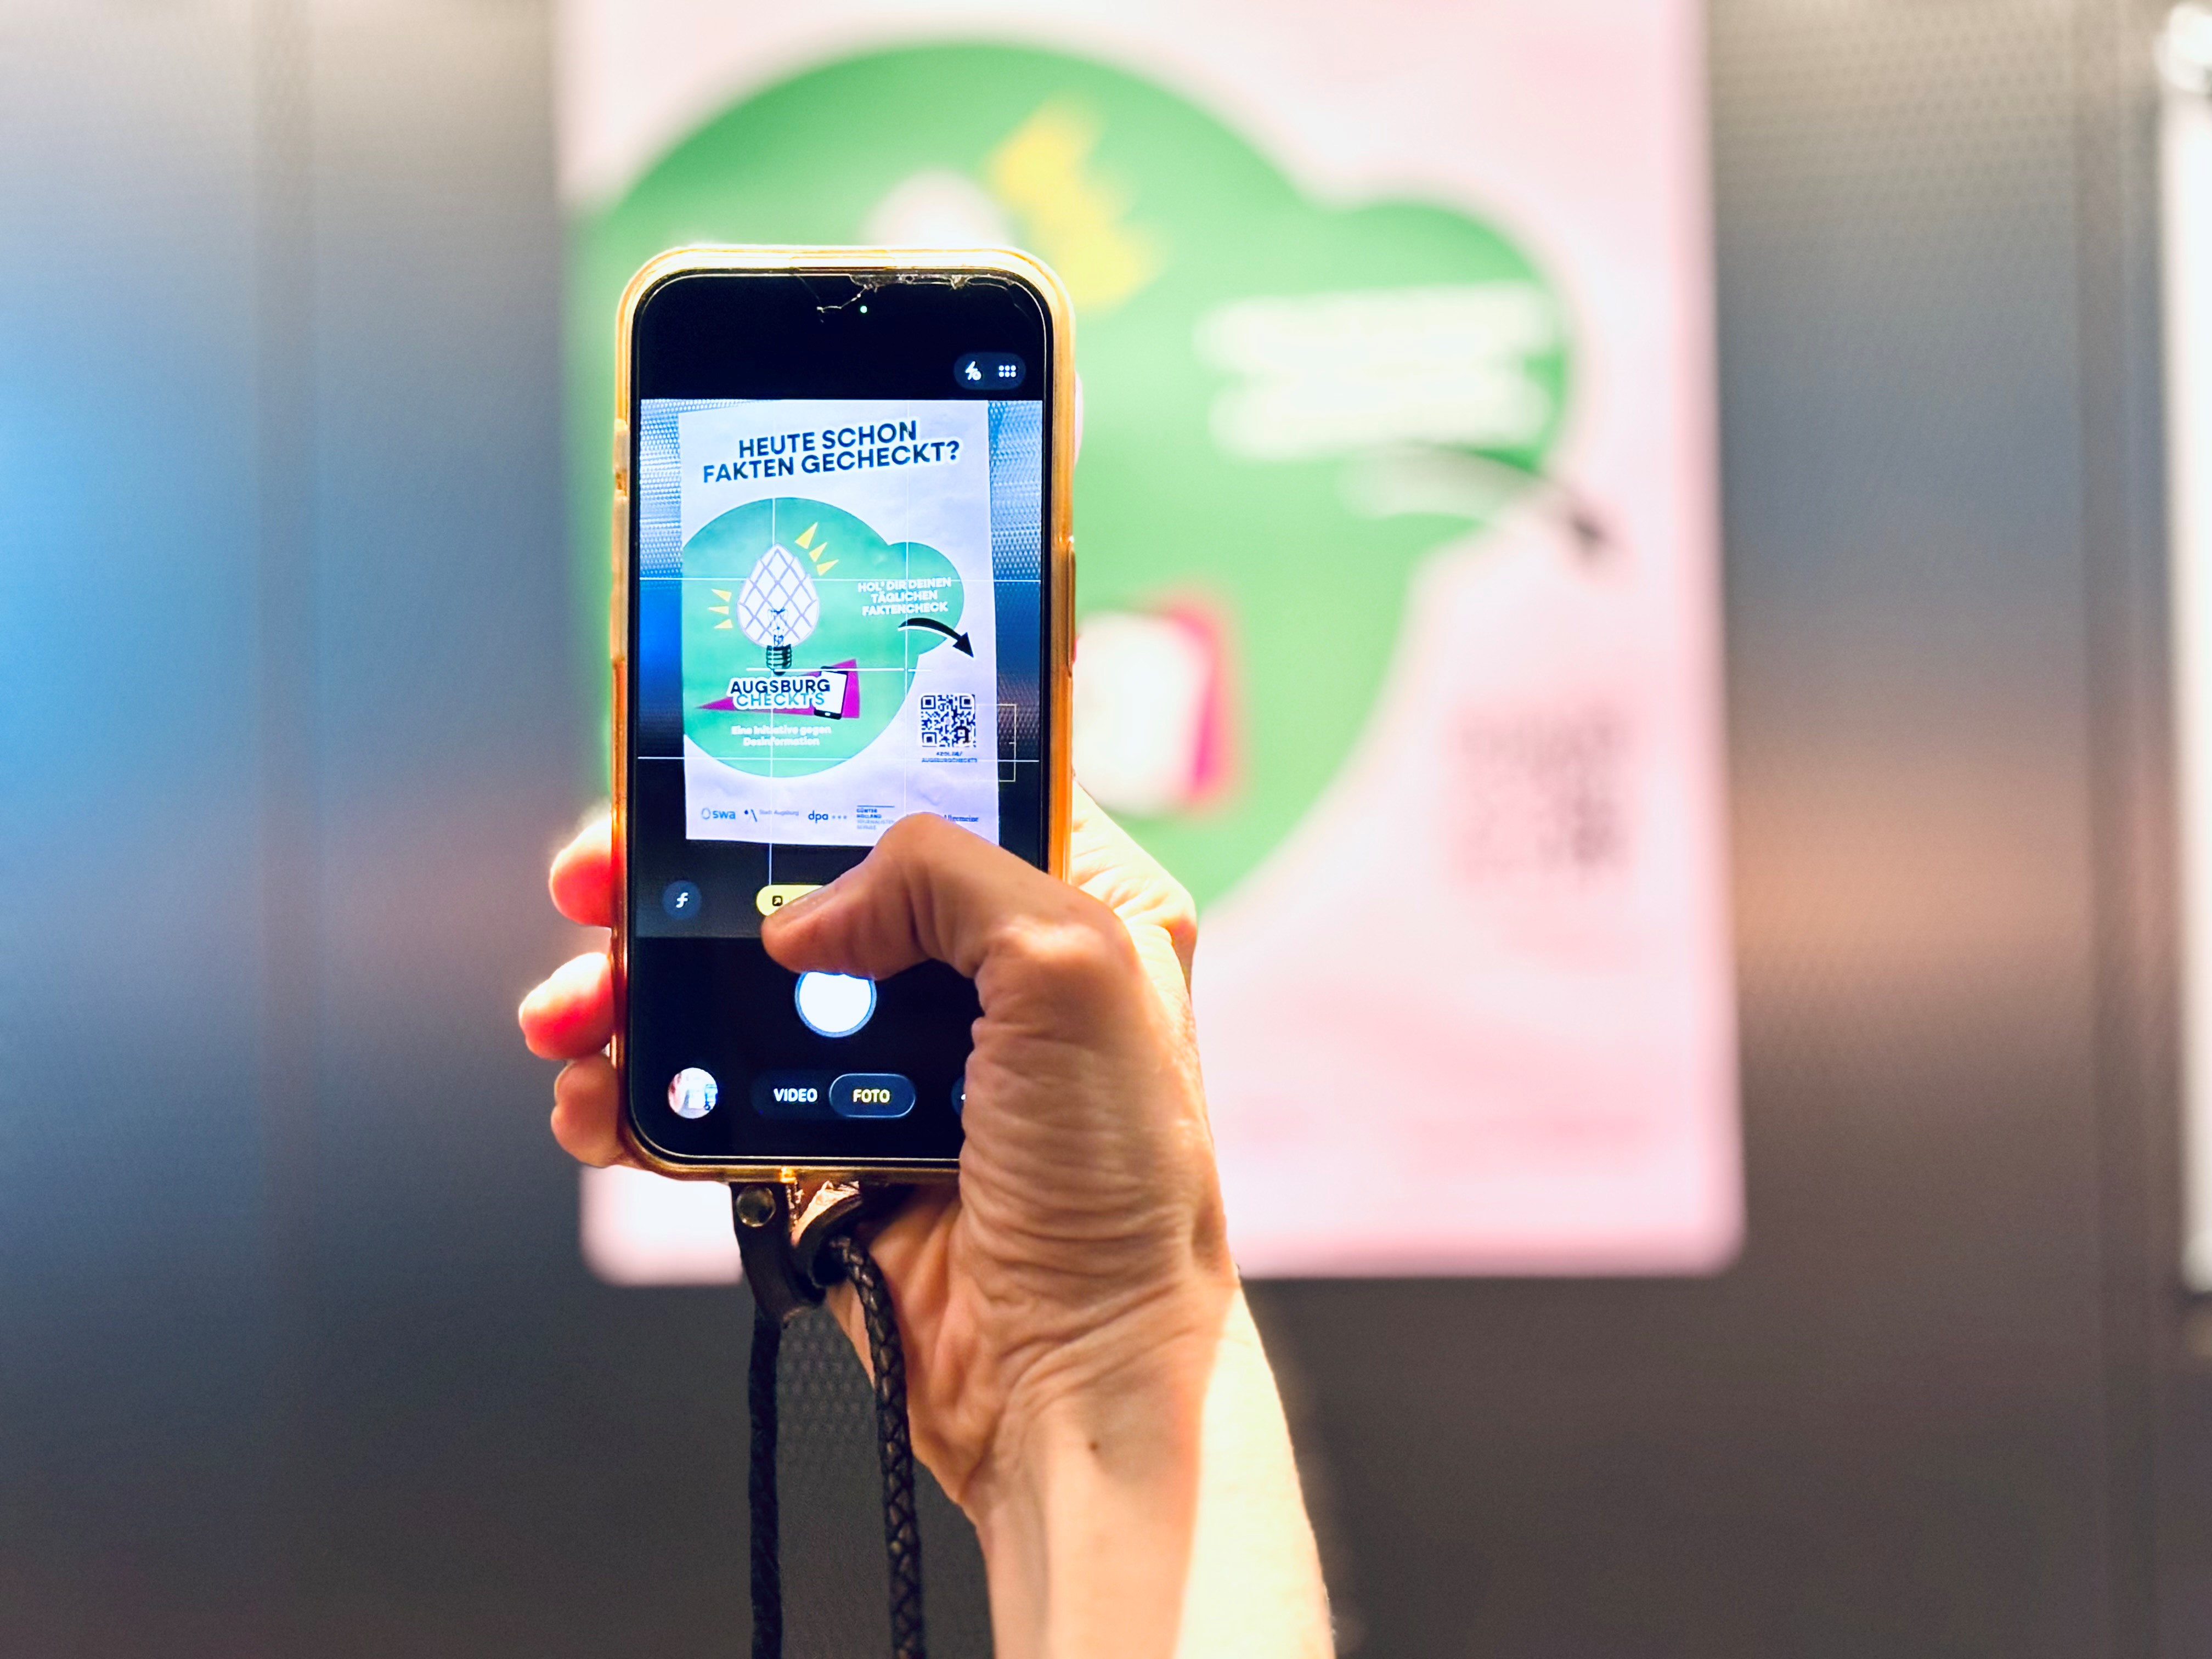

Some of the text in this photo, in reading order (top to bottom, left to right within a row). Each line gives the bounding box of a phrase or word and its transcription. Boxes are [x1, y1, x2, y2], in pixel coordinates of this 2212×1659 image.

[739, 420, 916, 458] HEUTE SCHON
[703, 440, 960, 483] FAKTEN GECHECKT?
[886, 580, 906, 590] DIR
[908, 577, 951, 589] DEINEN
[871, 589, 938, 604] TÄGLICHEN
[862, 602, 948, 616] FAKTENCHECK
[730, 679, 830, 694] AUGSBURG
[731, 725, 753, 735] Eine
[799, 726, 832, 736] gegen
[743, 736, 820, 746] Desinformation
[712, 810, 736, 820] swa
[808, 810, 829, 823] dpa
[773, 1088, 818, 1103] VIDEO
[852, 1088, 890, 1103] FOTO
